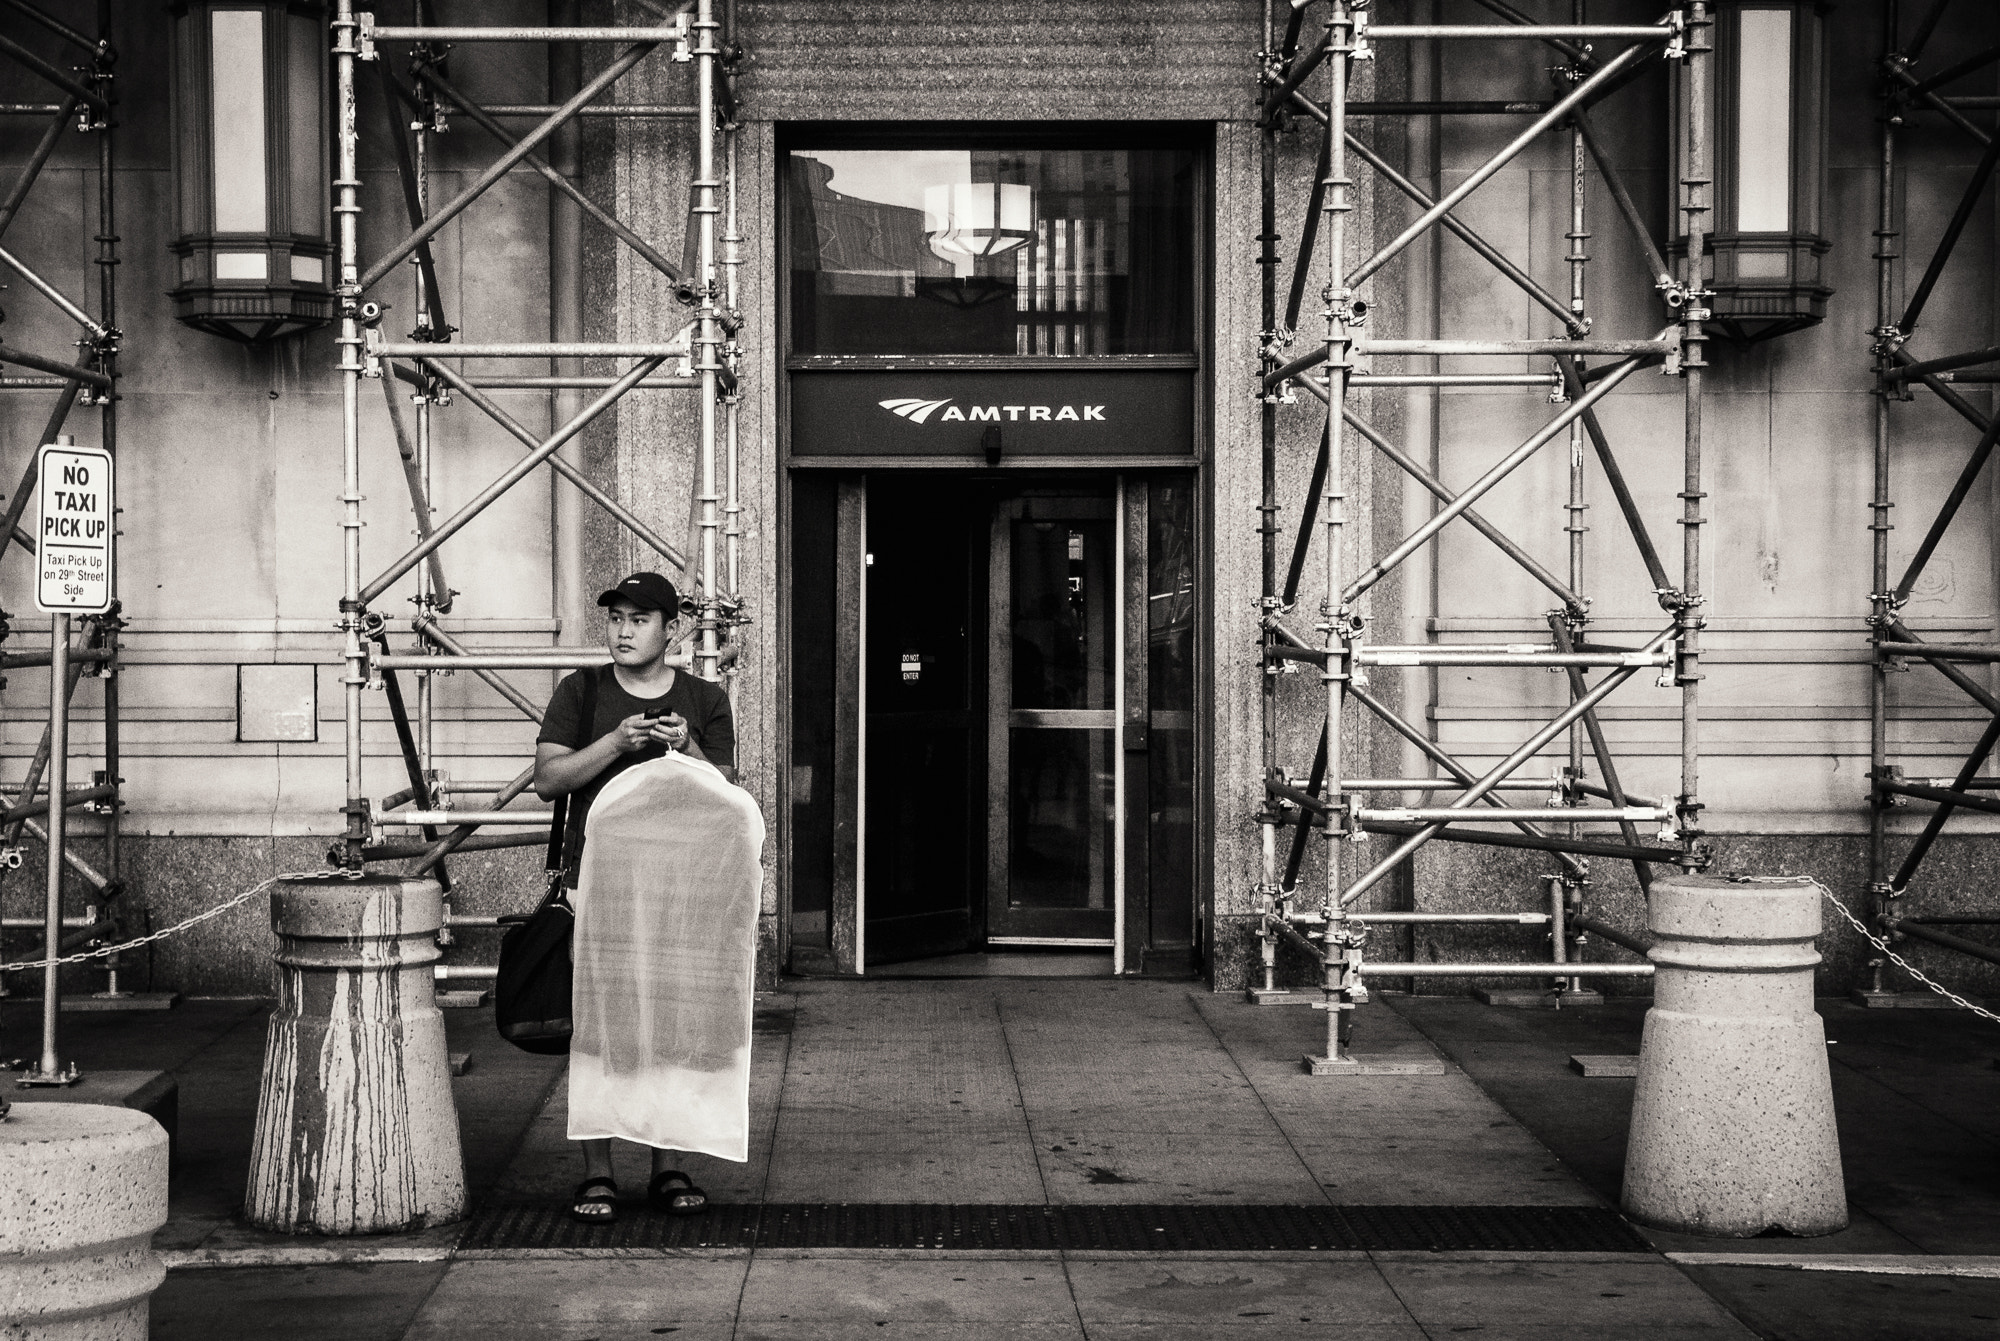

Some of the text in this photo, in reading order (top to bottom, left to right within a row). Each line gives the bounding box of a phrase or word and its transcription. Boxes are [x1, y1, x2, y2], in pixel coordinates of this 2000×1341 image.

[941, 405, 1106, 421] AMTRAK
[63, 466, 90, 486] NO
[55, 491, 96, 512] TAXI
[45, 517, 105, 539] PICK UP
[47, 554, 102, 569] Taxi Pick Up
[44, 569, 104, 582] on 29th Street
[64, 584, 84, 595] Side
[903, 672, 919, 680] ENTER
